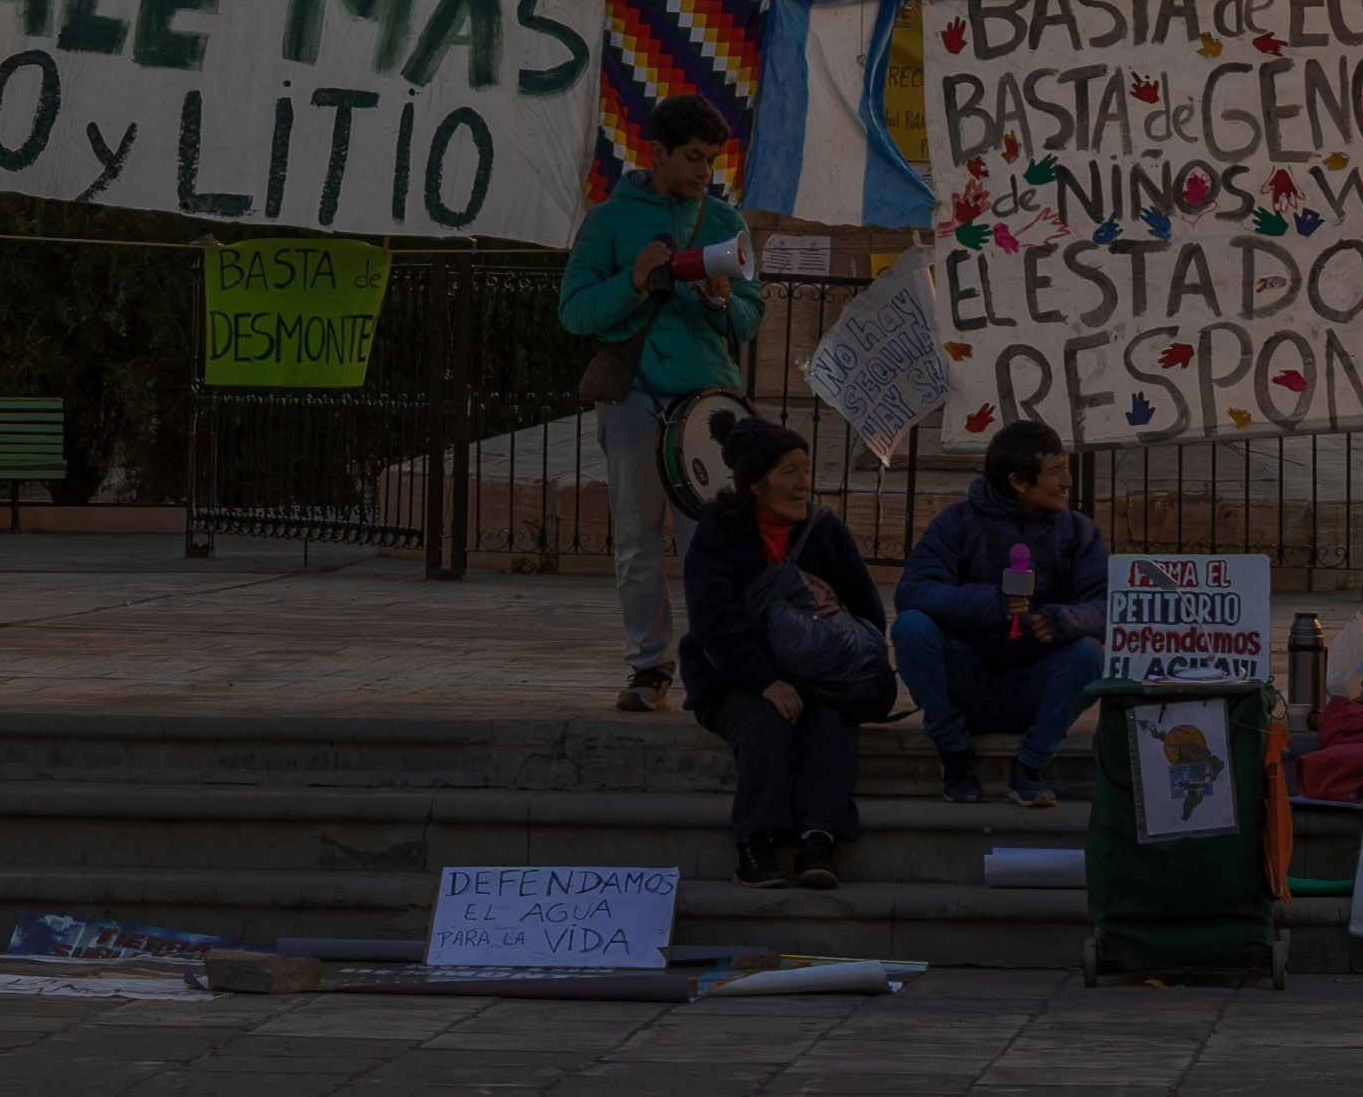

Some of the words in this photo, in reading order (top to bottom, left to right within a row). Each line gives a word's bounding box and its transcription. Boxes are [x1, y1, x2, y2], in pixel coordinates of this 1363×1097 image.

[943, 63, 1133, 167] BASTA
[1143, 71, 1199, 143] de
[991, 174, 1042, 218] de
[219, 248, 337, 292] BASTA
[353, 257, 382, 289] de
[946, 248, 1016, 331] EL
[209, 310, 375, 364] DESMONTE
[1205, 560, 1232, 588] EL
[1110, 590, 1242, 626] PETITORIO
[445, 869, 678, 897] DEFENDAMOS
[464, 903, 497, 921] EL
[518, 899, 612, 923] AGUA
[438, 929, 491, 948] PARA
